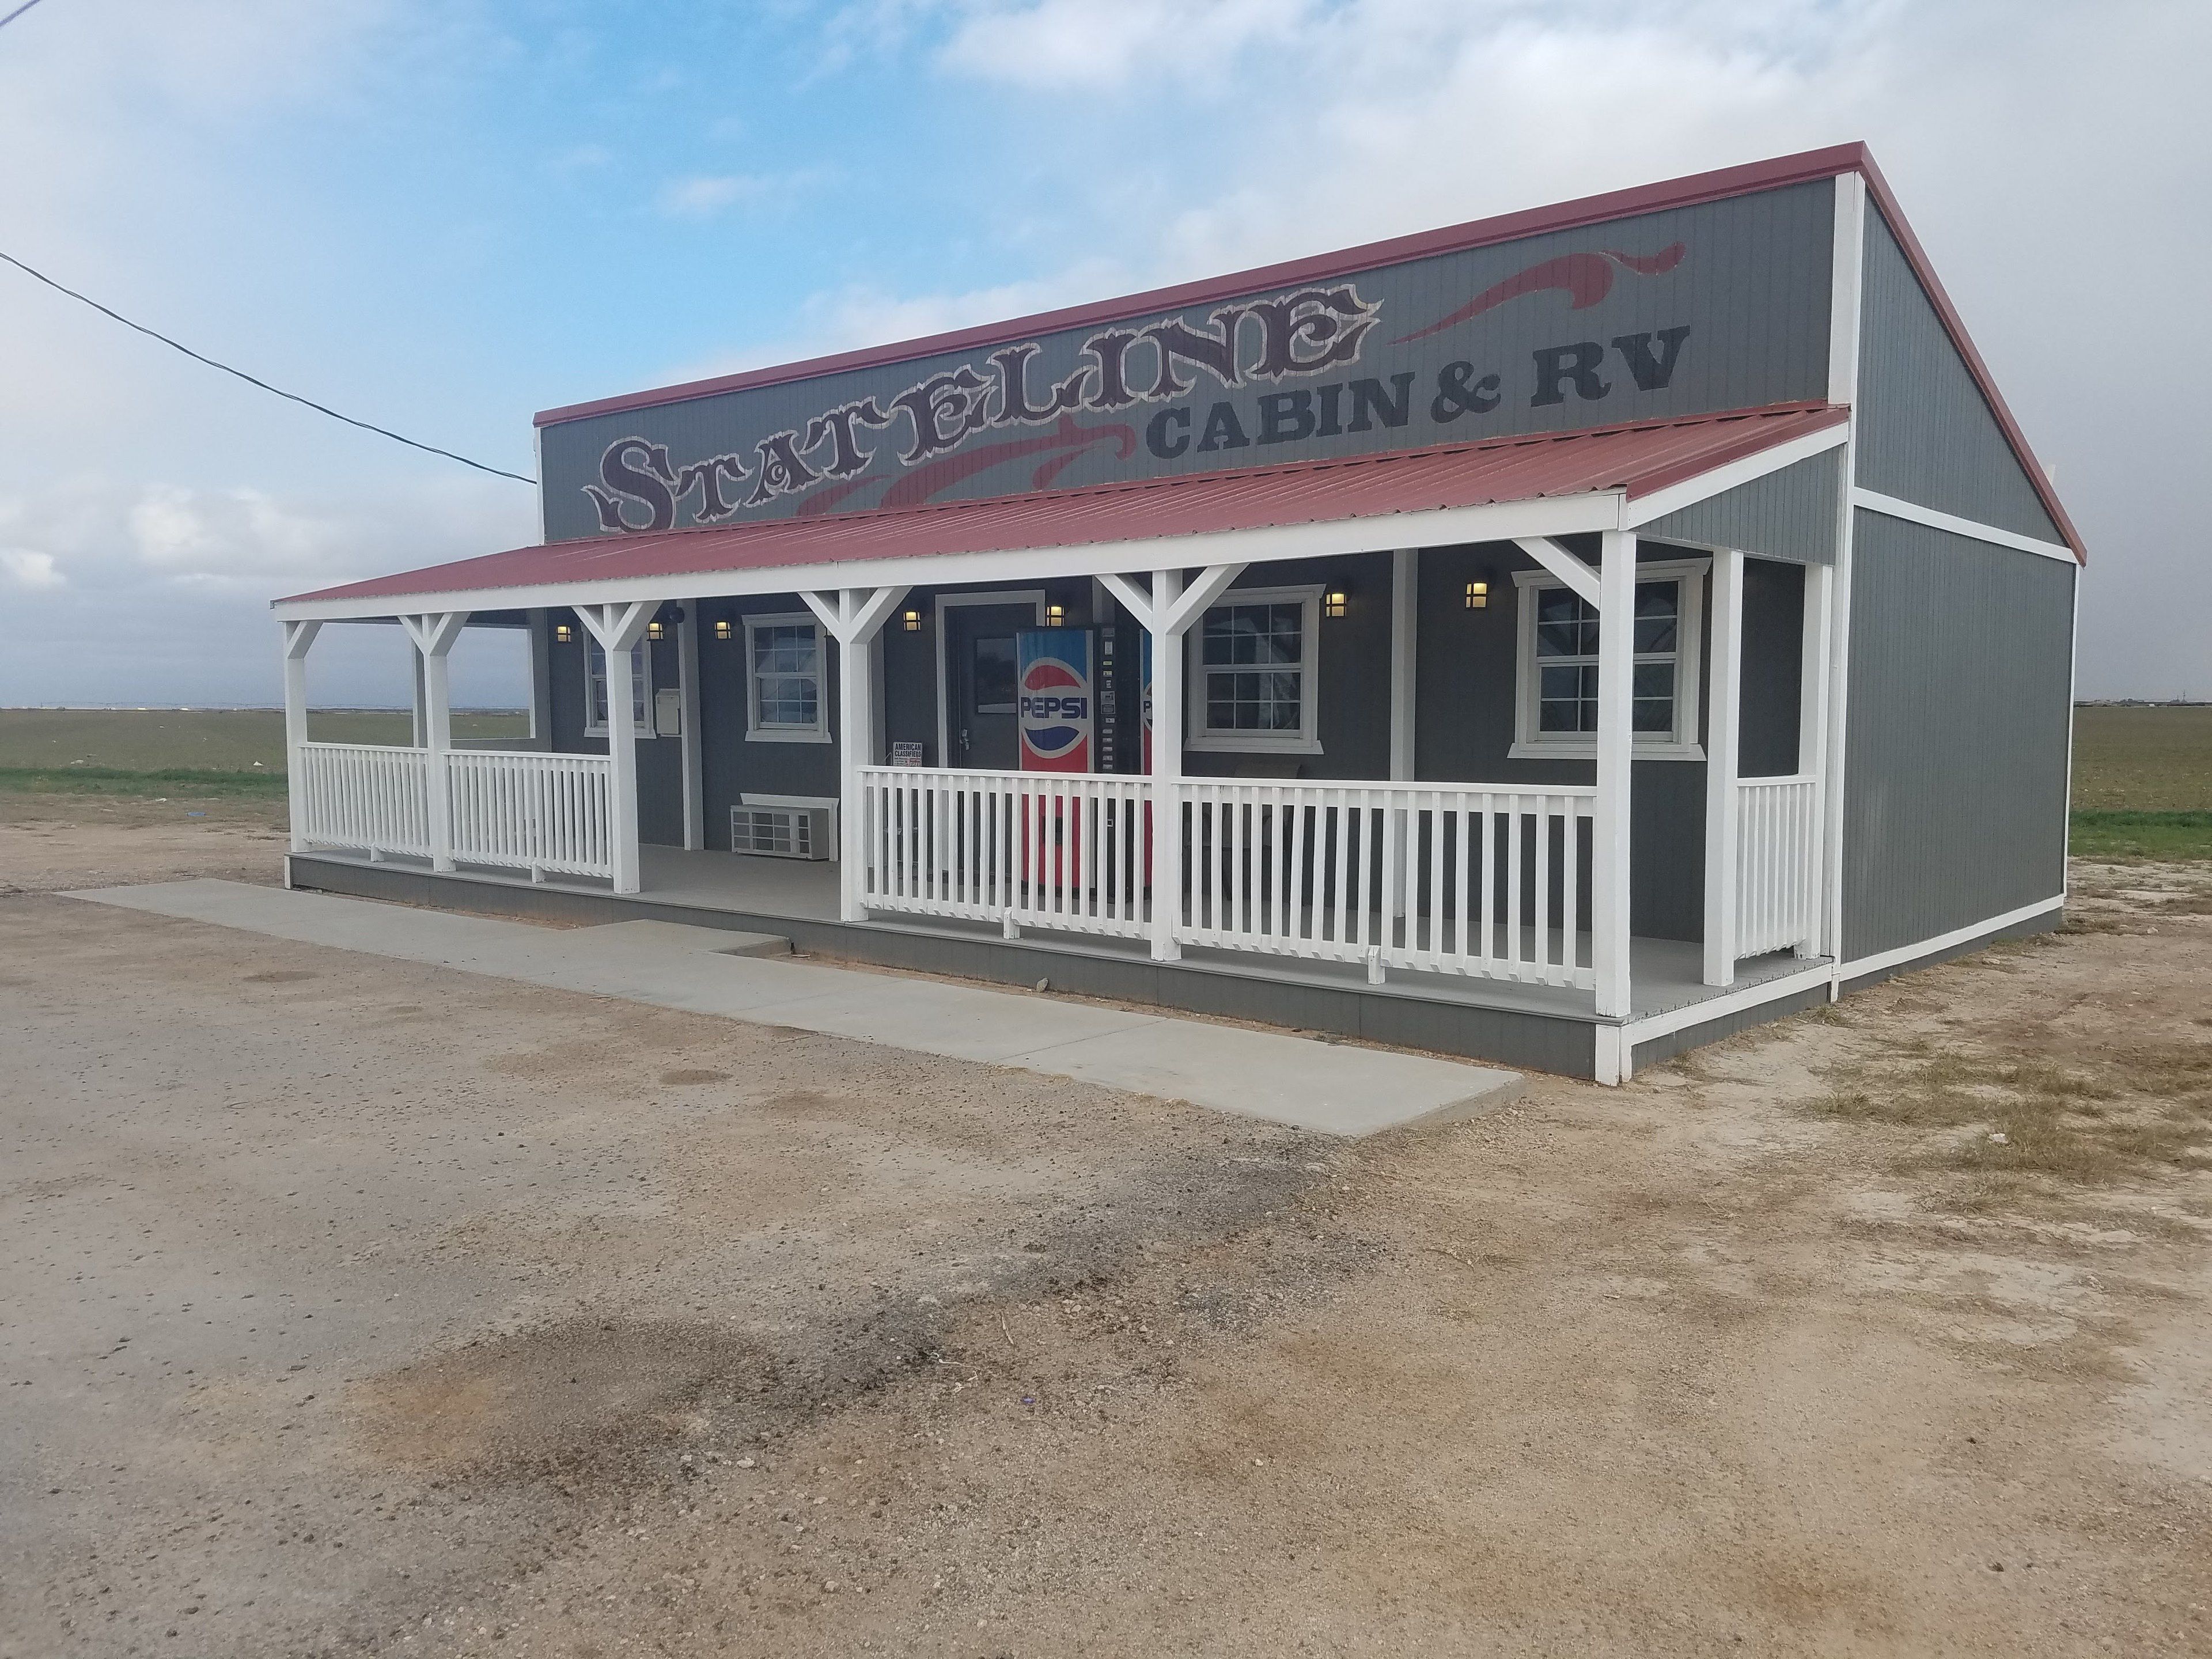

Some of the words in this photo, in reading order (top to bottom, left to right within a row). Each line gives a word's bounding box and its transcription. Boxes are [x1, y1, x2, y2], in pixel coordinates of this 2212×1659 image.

[1146, 373, 1415, 459] CABIN
[1430, 361, 1501, 423] &
[1531, 325, 1690, 407] RV
[1021, 697, 1088, 719] PEPSI
